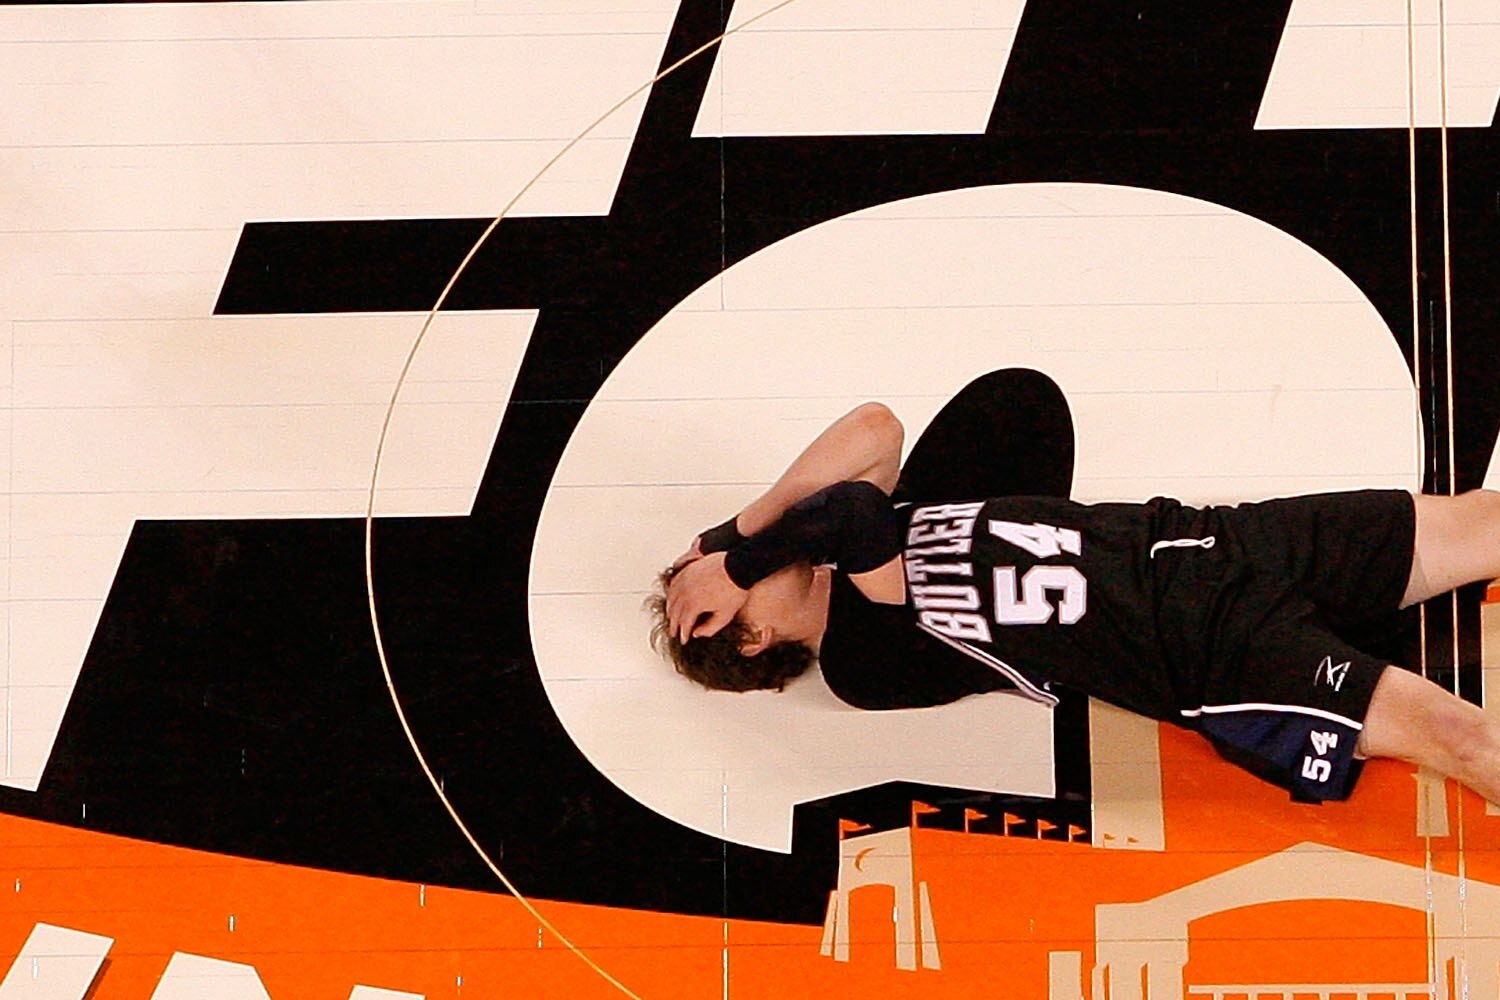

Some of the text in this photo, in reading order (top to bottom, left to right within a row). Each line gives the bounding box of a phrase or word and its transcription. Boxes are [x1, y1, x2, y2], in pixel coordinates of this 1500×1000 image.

[905, 501, 992, 643] BUTLER
[988, 519, 1087, 625] 54
[1301, 730, 1339, 783] 54
